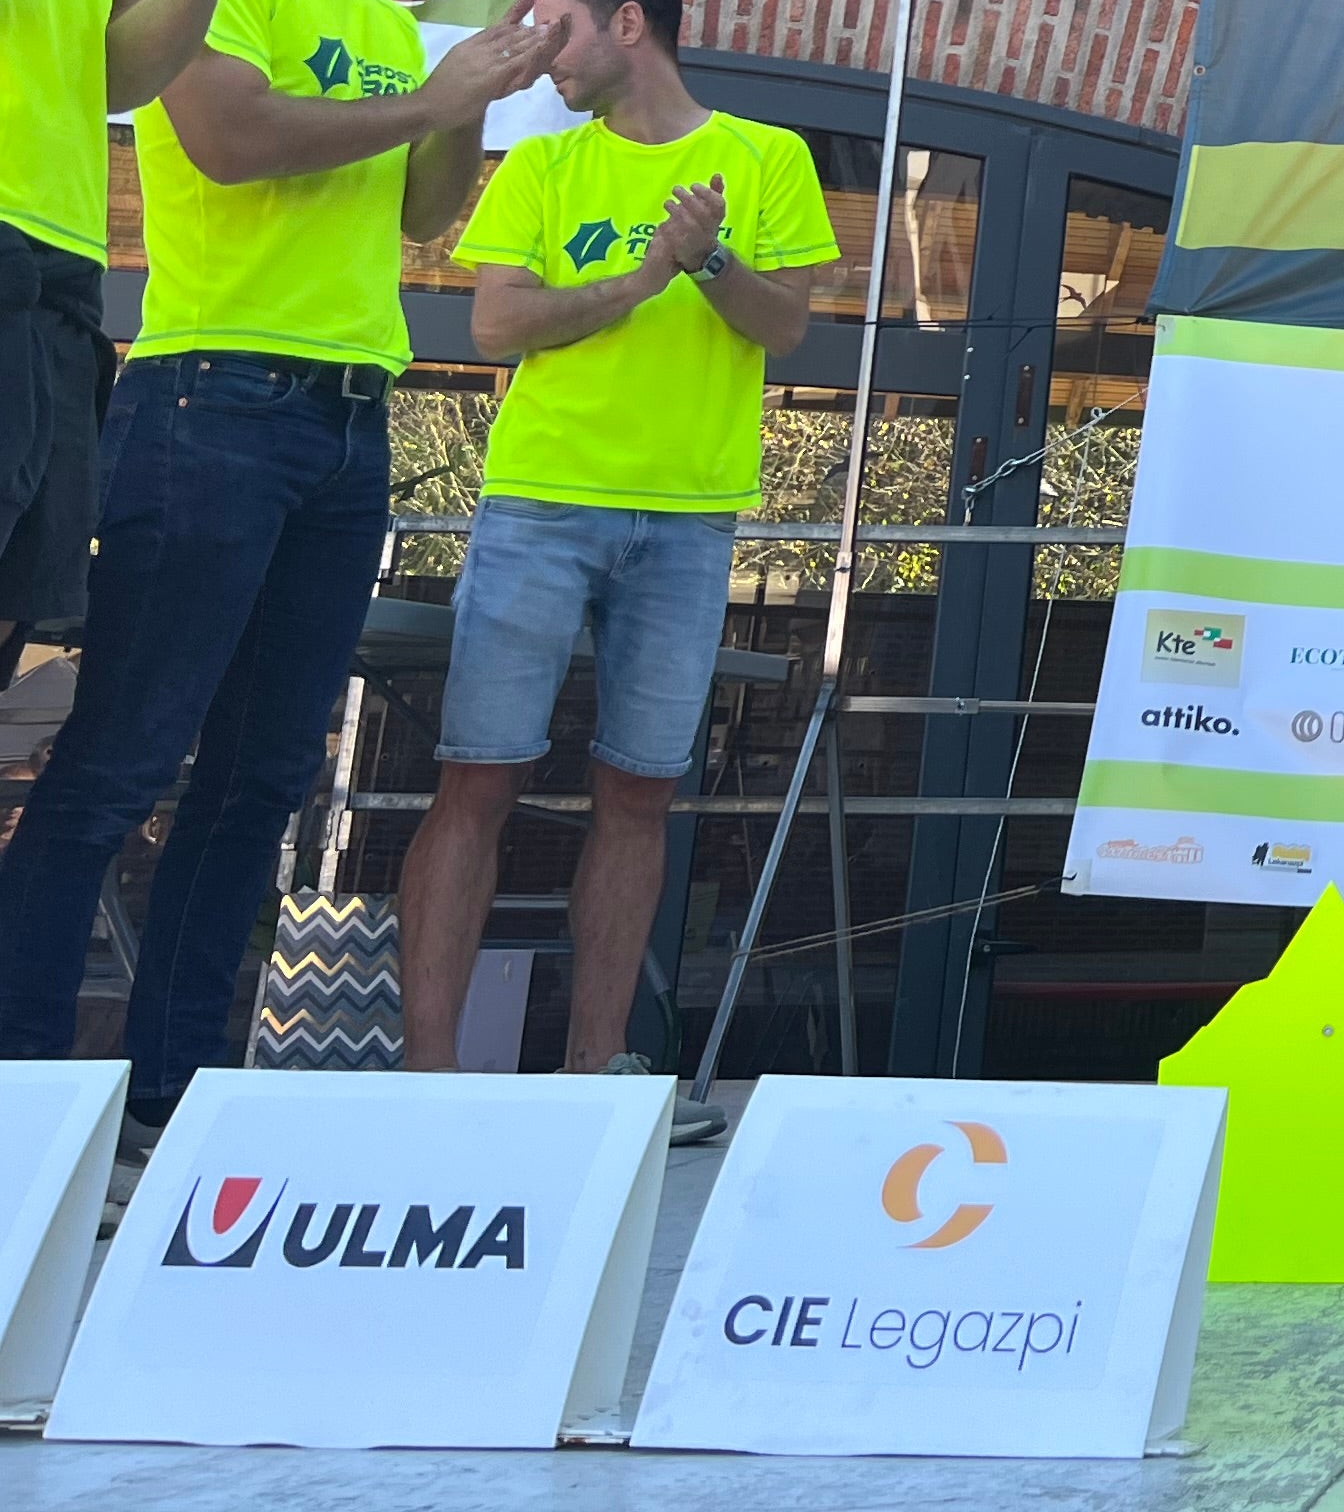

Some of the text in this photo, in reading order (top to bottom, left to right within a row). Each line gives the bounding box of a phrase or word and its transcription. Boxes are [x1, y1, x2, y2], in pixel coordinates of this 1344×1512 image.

[1156, 629, 1196, 656] Kte
[280, 1201, 529, 1271] ULMA
[722, 1293, 1085, 1371] CIE Legazpi
